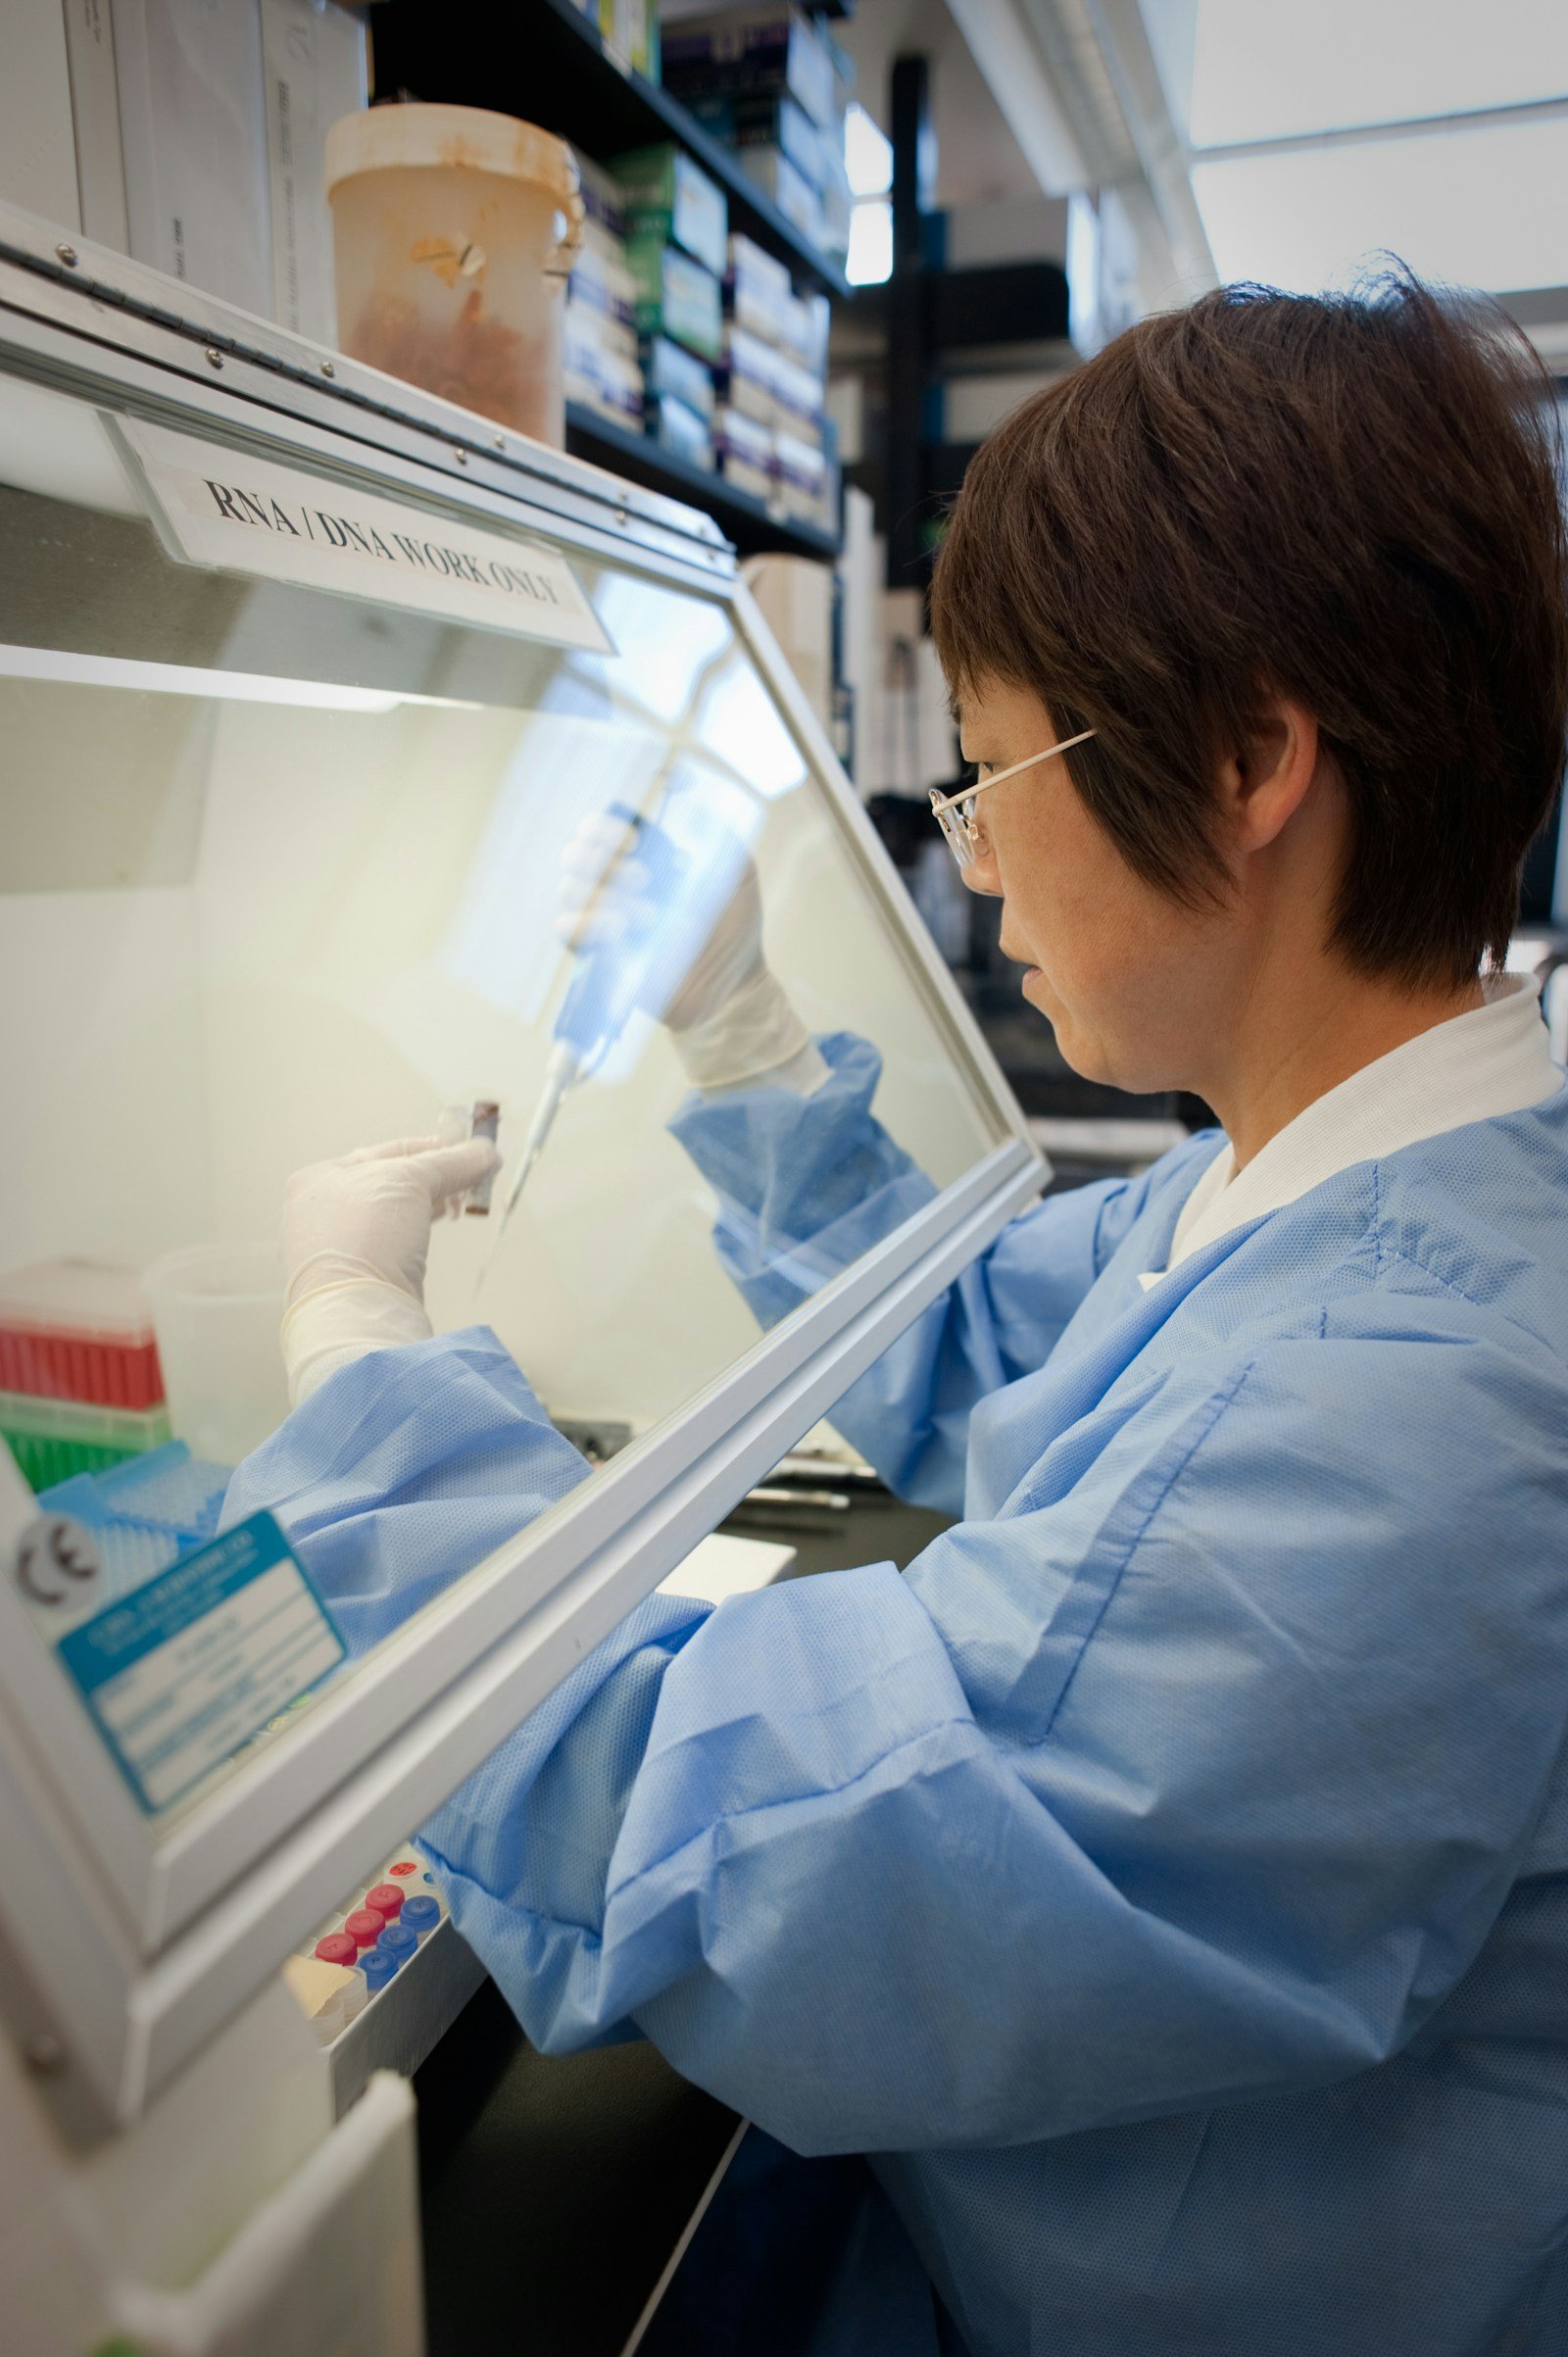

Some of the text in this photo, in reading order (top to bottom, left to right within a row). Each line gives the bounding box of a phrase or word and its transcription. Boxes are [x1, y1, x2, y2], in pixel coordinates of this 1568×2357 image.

[203, 479, 301, 536] RNA
[316, 512, 396, 562] DNA
[393, 533, 491, 587] WORK
[489, 562, 560, 605] ONLY
